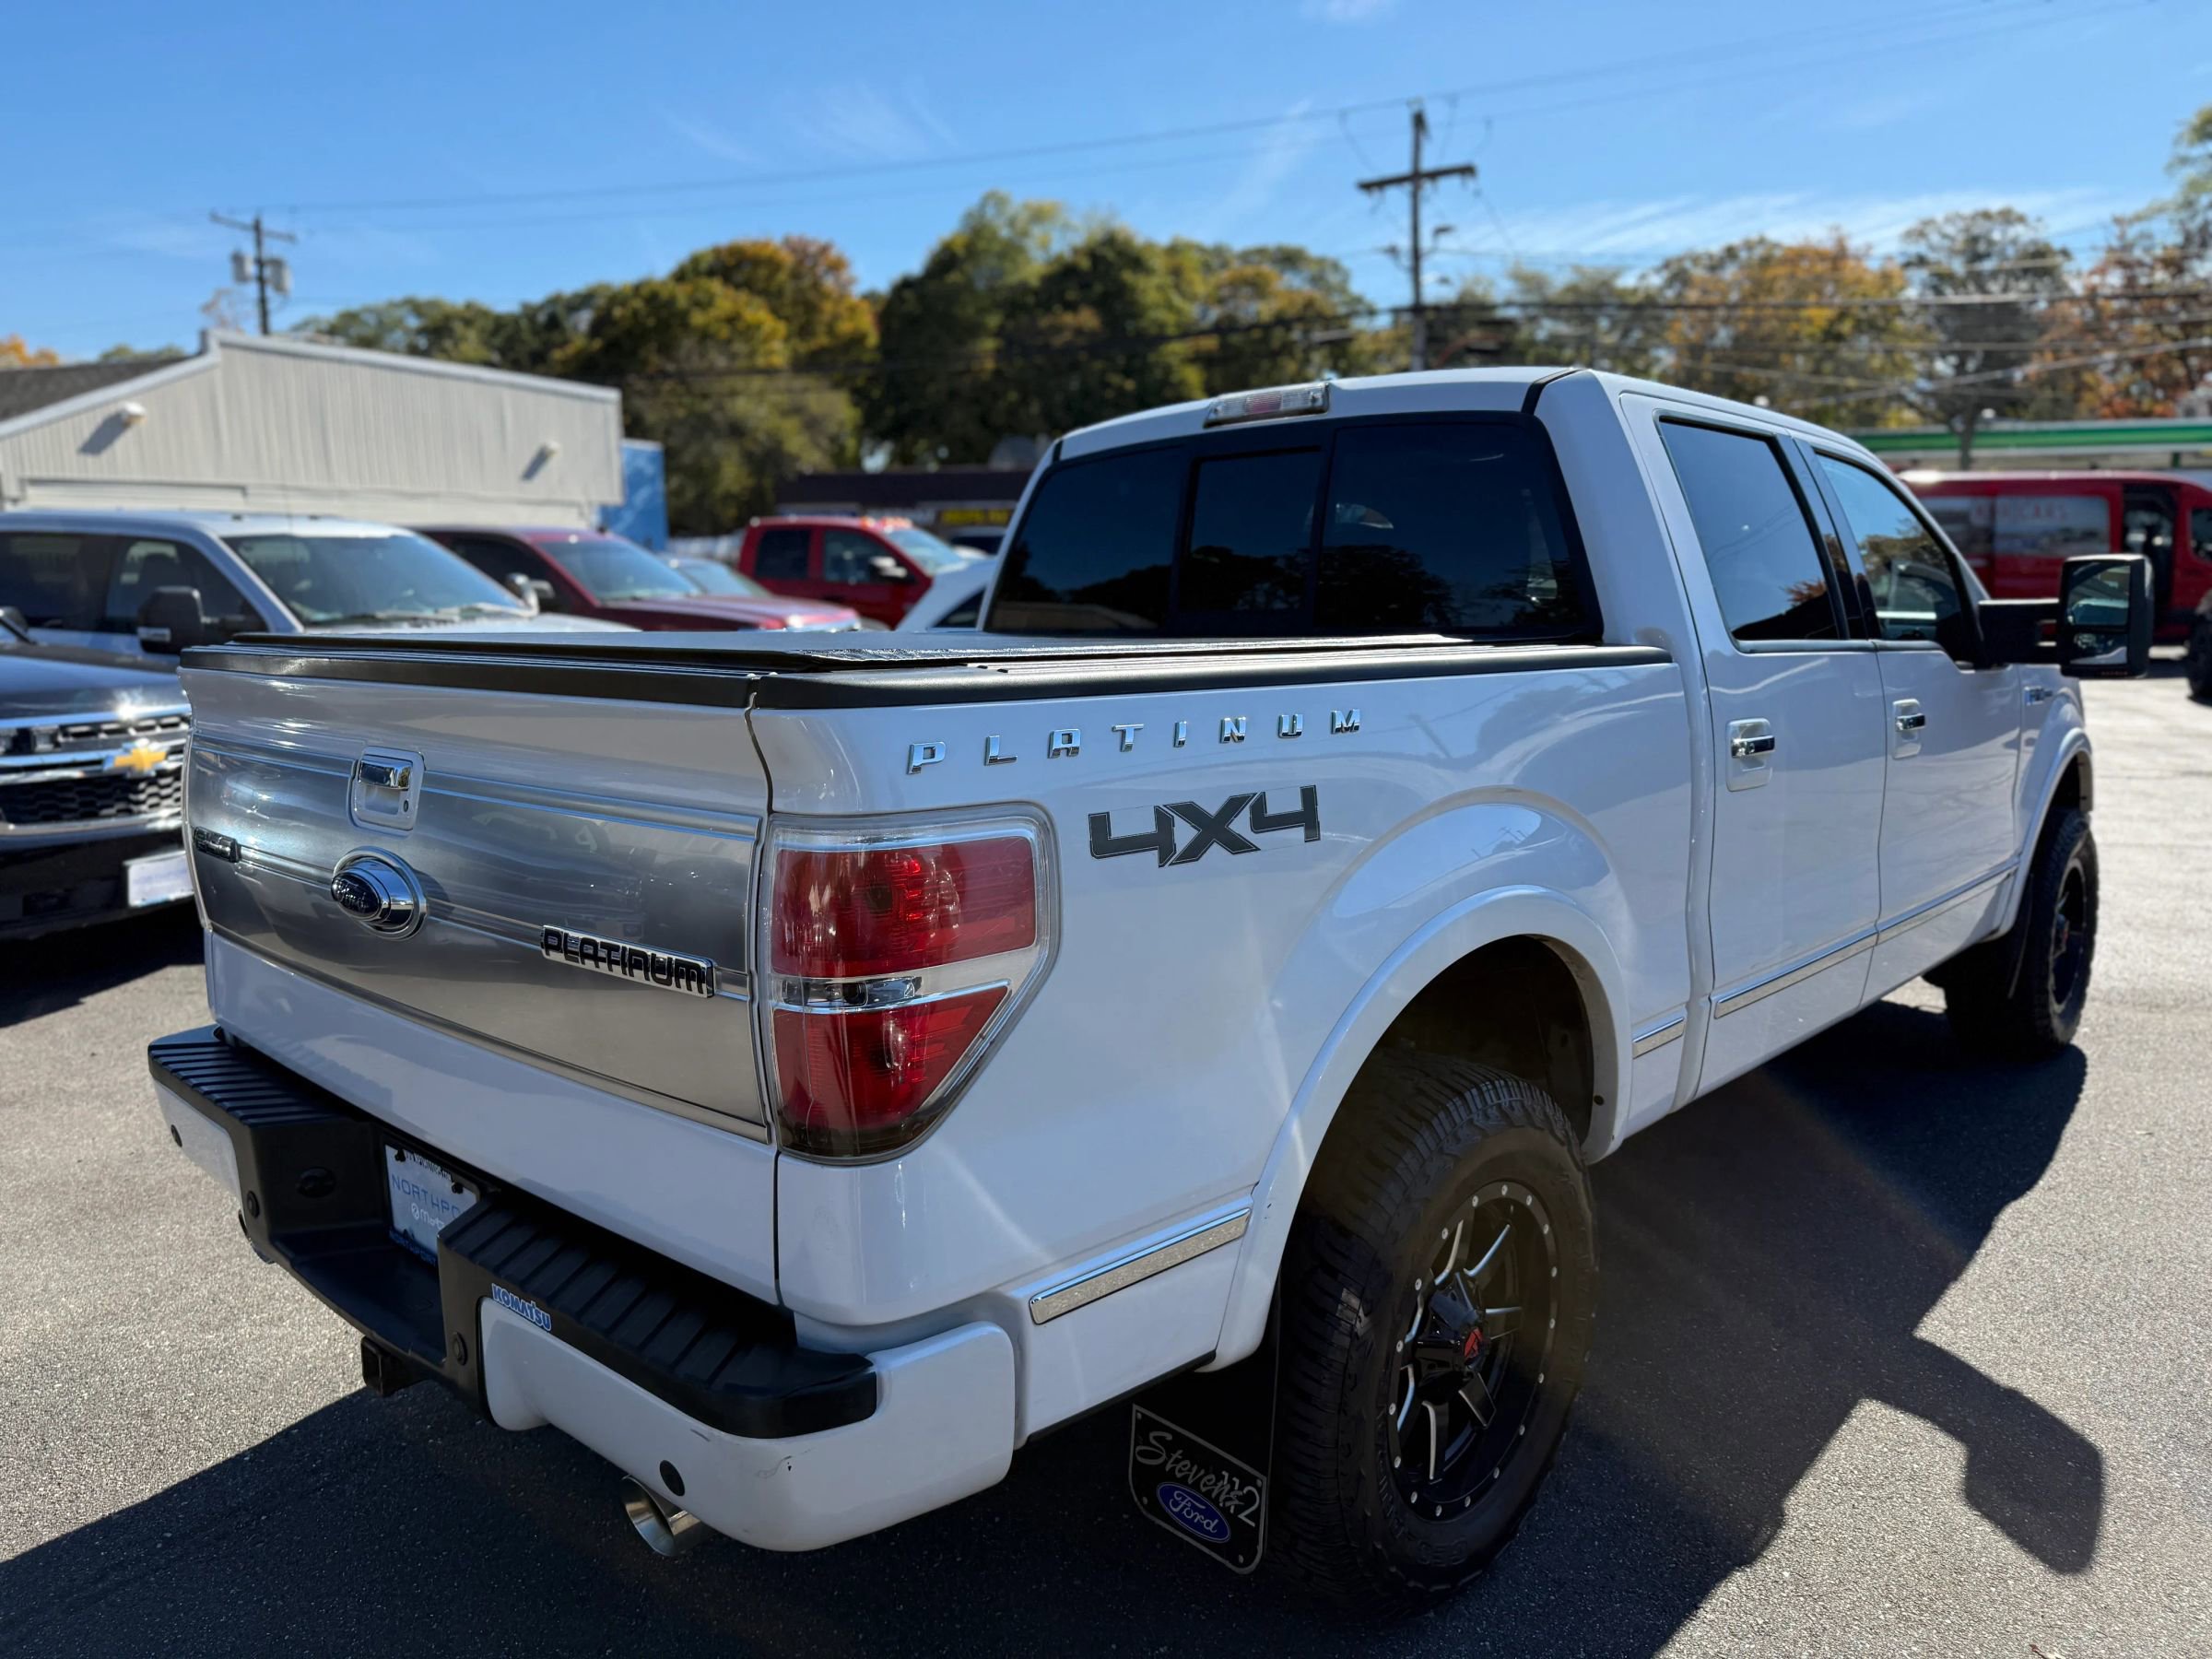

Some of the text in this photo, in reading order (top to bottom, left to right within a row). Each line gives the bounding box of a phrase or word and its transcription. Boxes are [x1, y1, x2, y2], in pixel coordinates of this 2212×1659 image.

[905, 709, 1361, 774] PLATINUM
[1088, 783, 1322, 868] 4X4
[543, 927, 705, 994] PLATINUM
[391, 1174, 460, 1218] NORTHPO
[491, 1282, 552, 1332] KOMATSU
[1169, 1489, 1218, 1534] Ford
